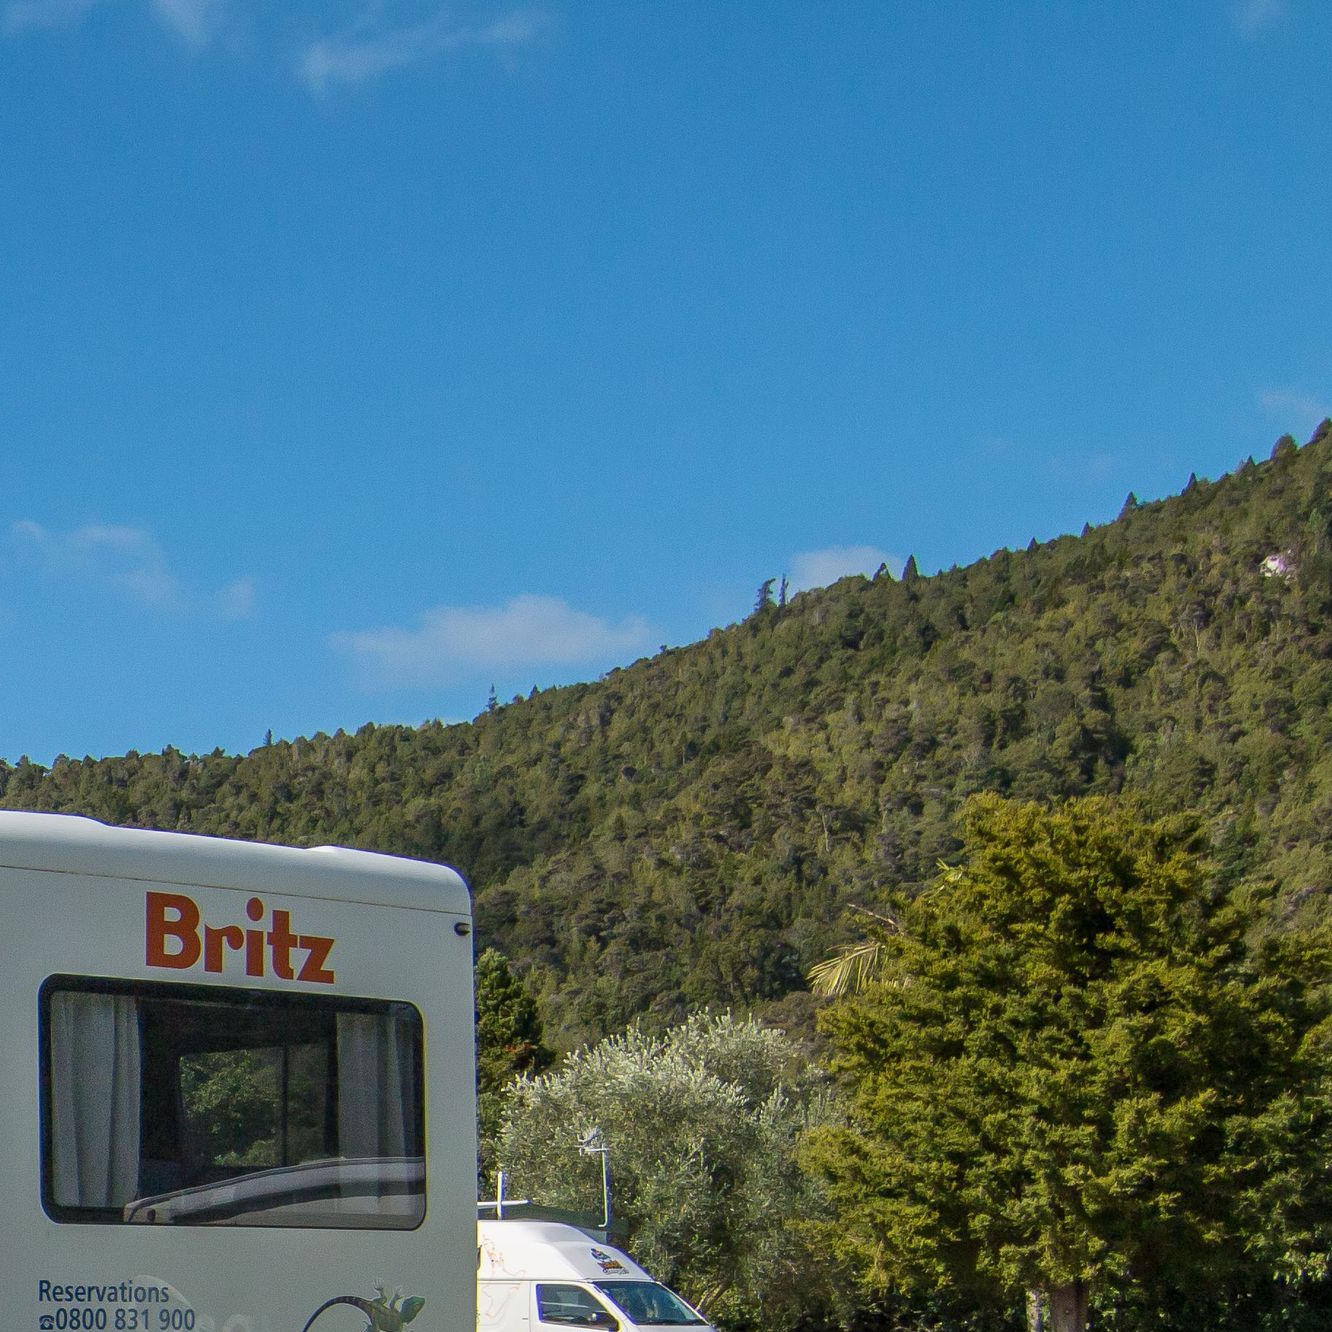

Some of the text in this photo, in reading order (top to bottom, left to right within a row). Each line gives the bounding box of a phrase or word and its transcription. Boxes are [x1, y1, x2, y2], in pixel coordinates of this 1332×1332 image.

[145, 890, 335, 985] Britz
[38, 1279, 169, 1303] Reservations
[55, 1307, 195, 1331] 0800 831 900
